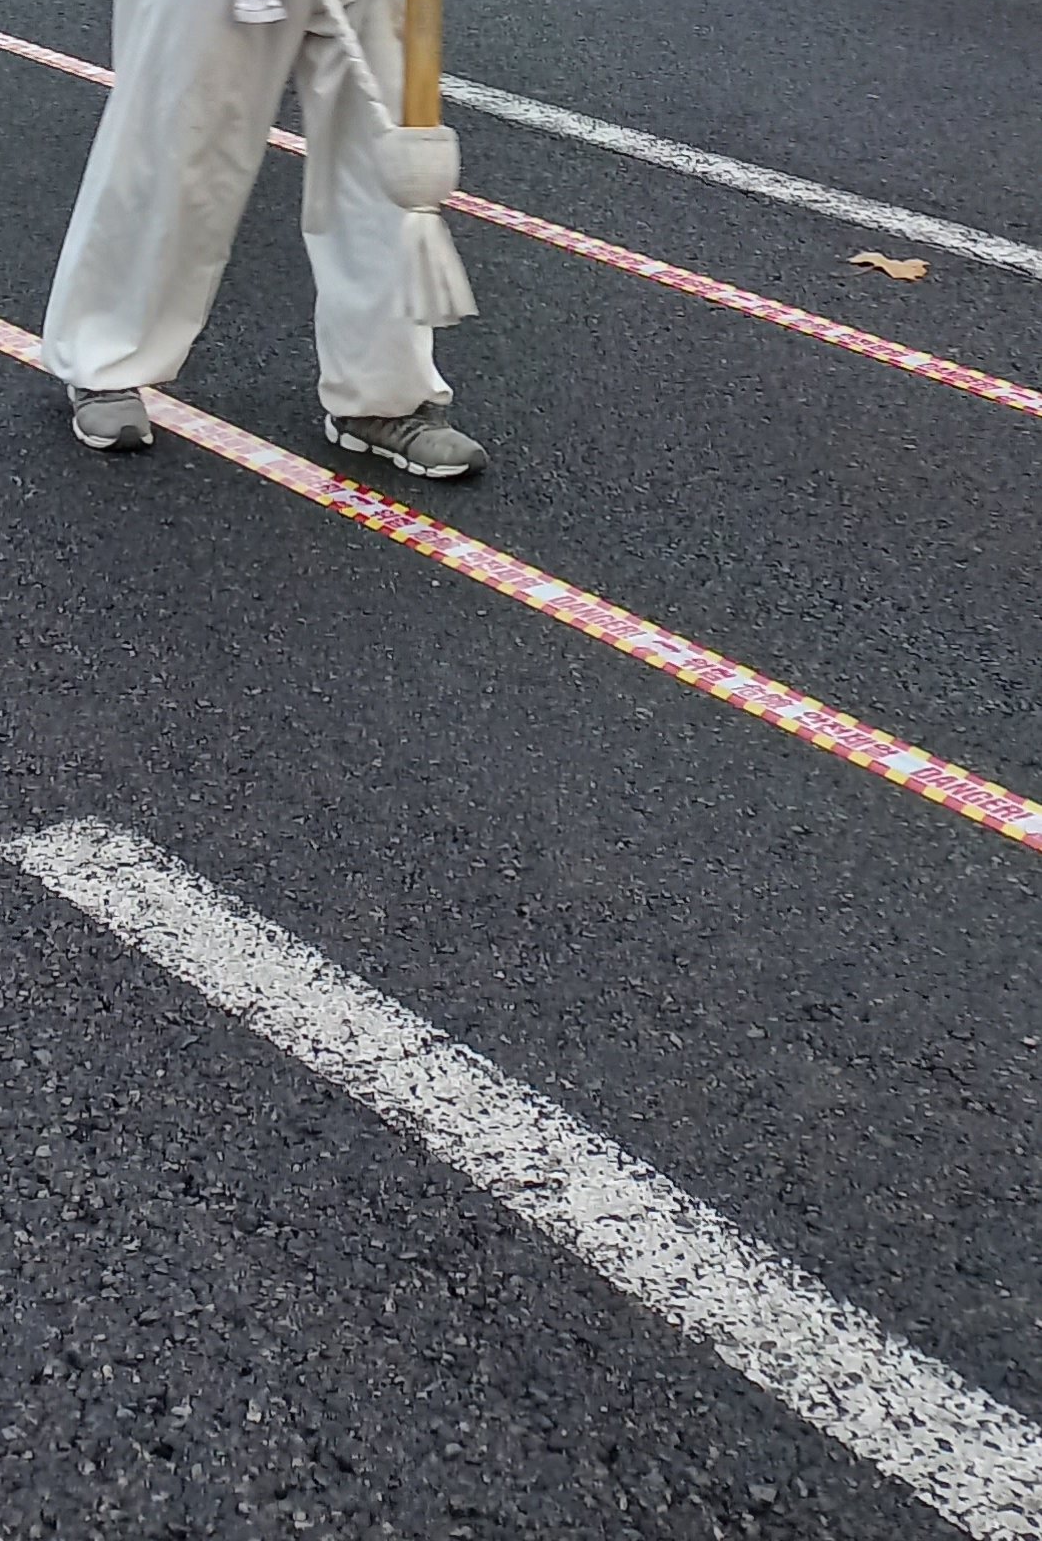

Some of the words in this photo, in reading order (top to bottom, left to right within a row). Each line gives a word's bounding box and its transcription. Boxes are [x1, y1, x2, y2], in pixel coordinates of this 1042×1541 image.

[549, 595, 648, 639] DANGER!
[681, 657, 738, 683] 위험
[791, 711, 900, 760] 안전제일
[909, 766, 1035, 822] DANGER!
